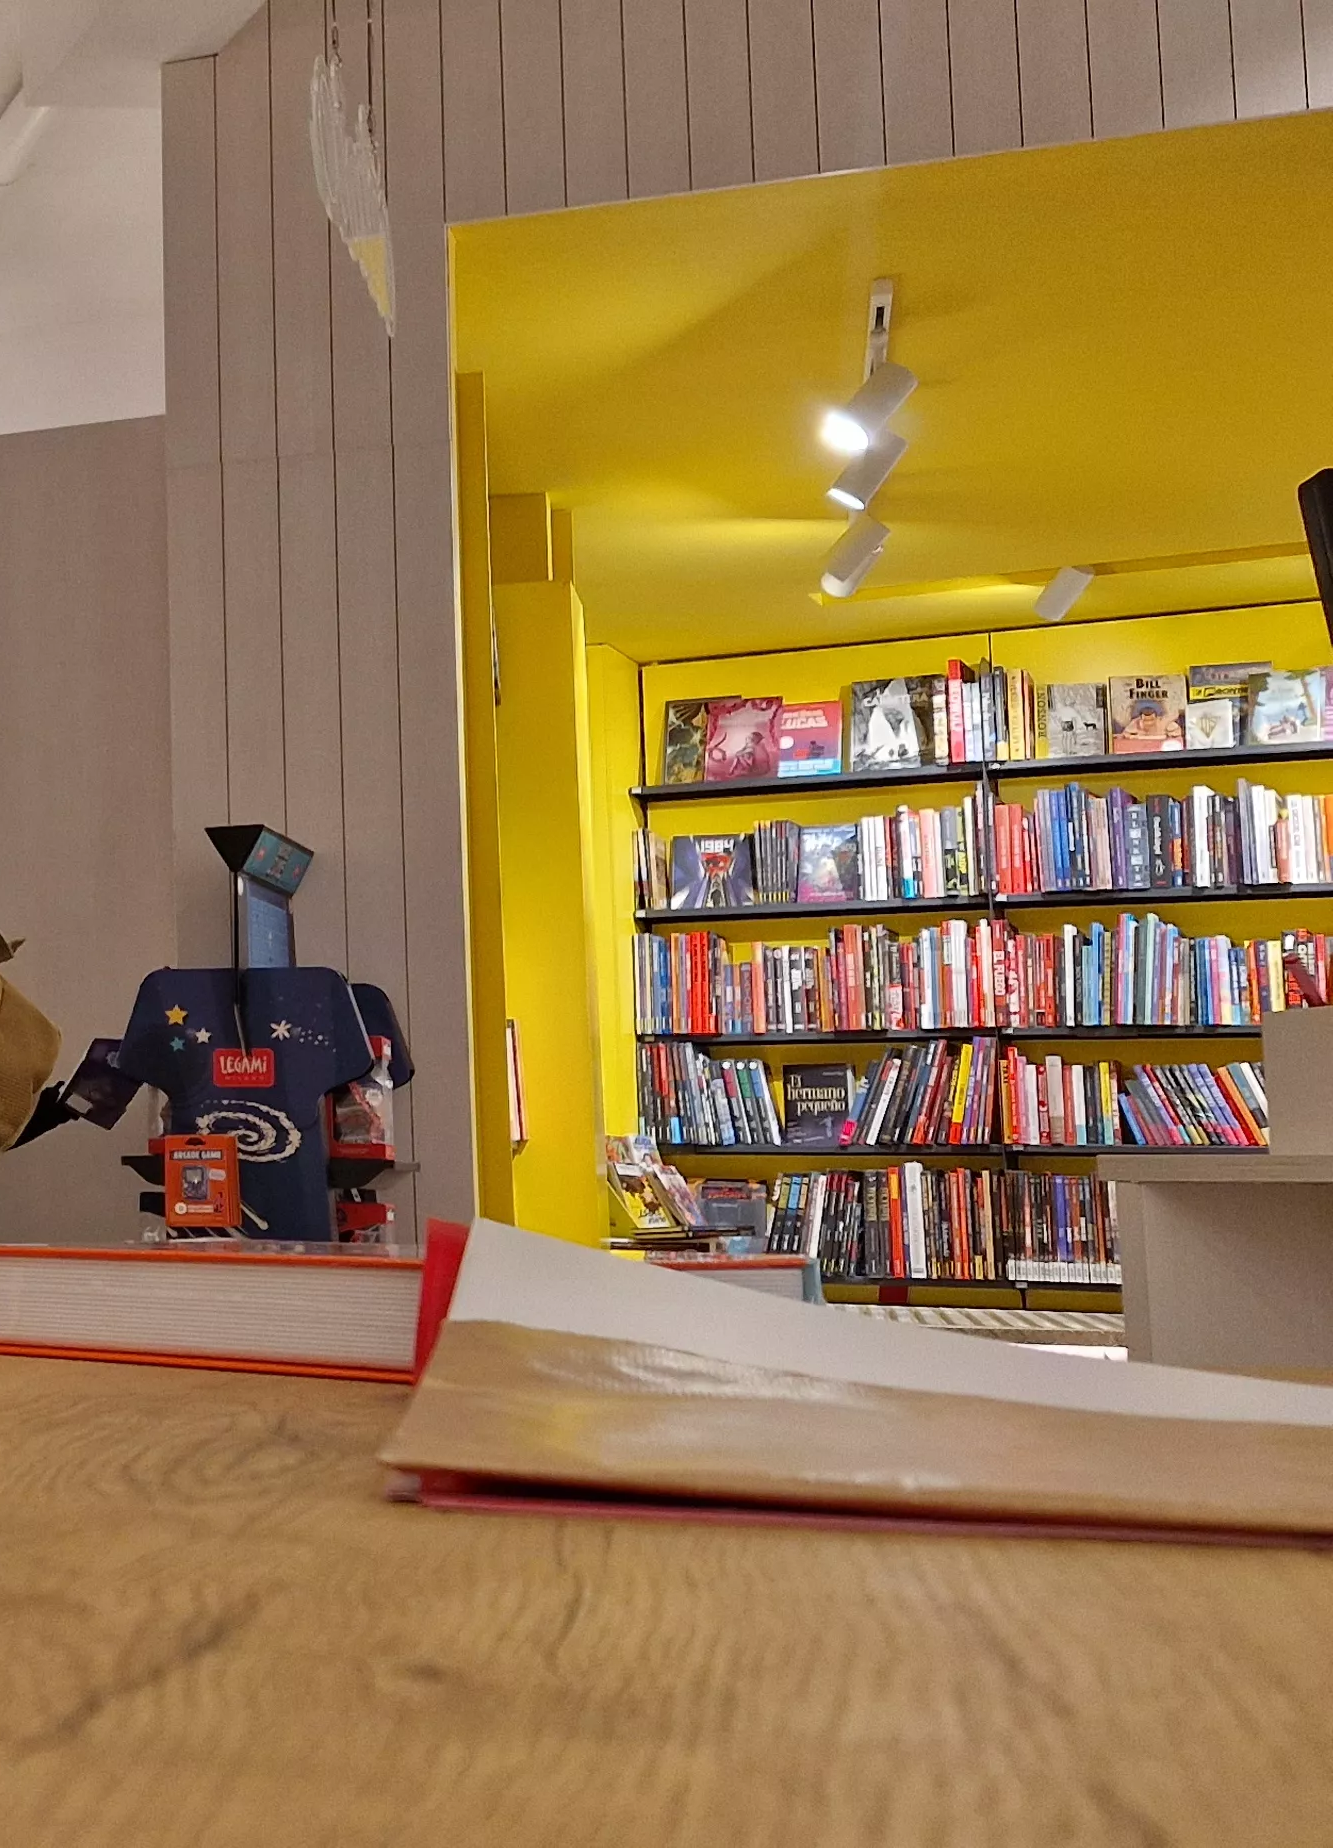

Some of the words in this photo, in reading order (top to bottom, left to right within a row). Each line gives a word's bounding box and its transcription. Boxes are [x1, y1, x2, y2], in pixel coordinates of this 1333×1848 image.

[1135, 678, 1162, 689] BILL
[1129, 688, 1169, 699] FINGER
[781, 715, 828, 730] LUCAS
[1037, 691, 1047, 739] RONSON
[700, 838, 735, 853] 1984
[993, 950, 1004, 963] EL
[994, 964, 1006, 996] FUEGO
[786, 1084, 846, 1101] hermano
[797, 1099, 846, 1117] pequeño
